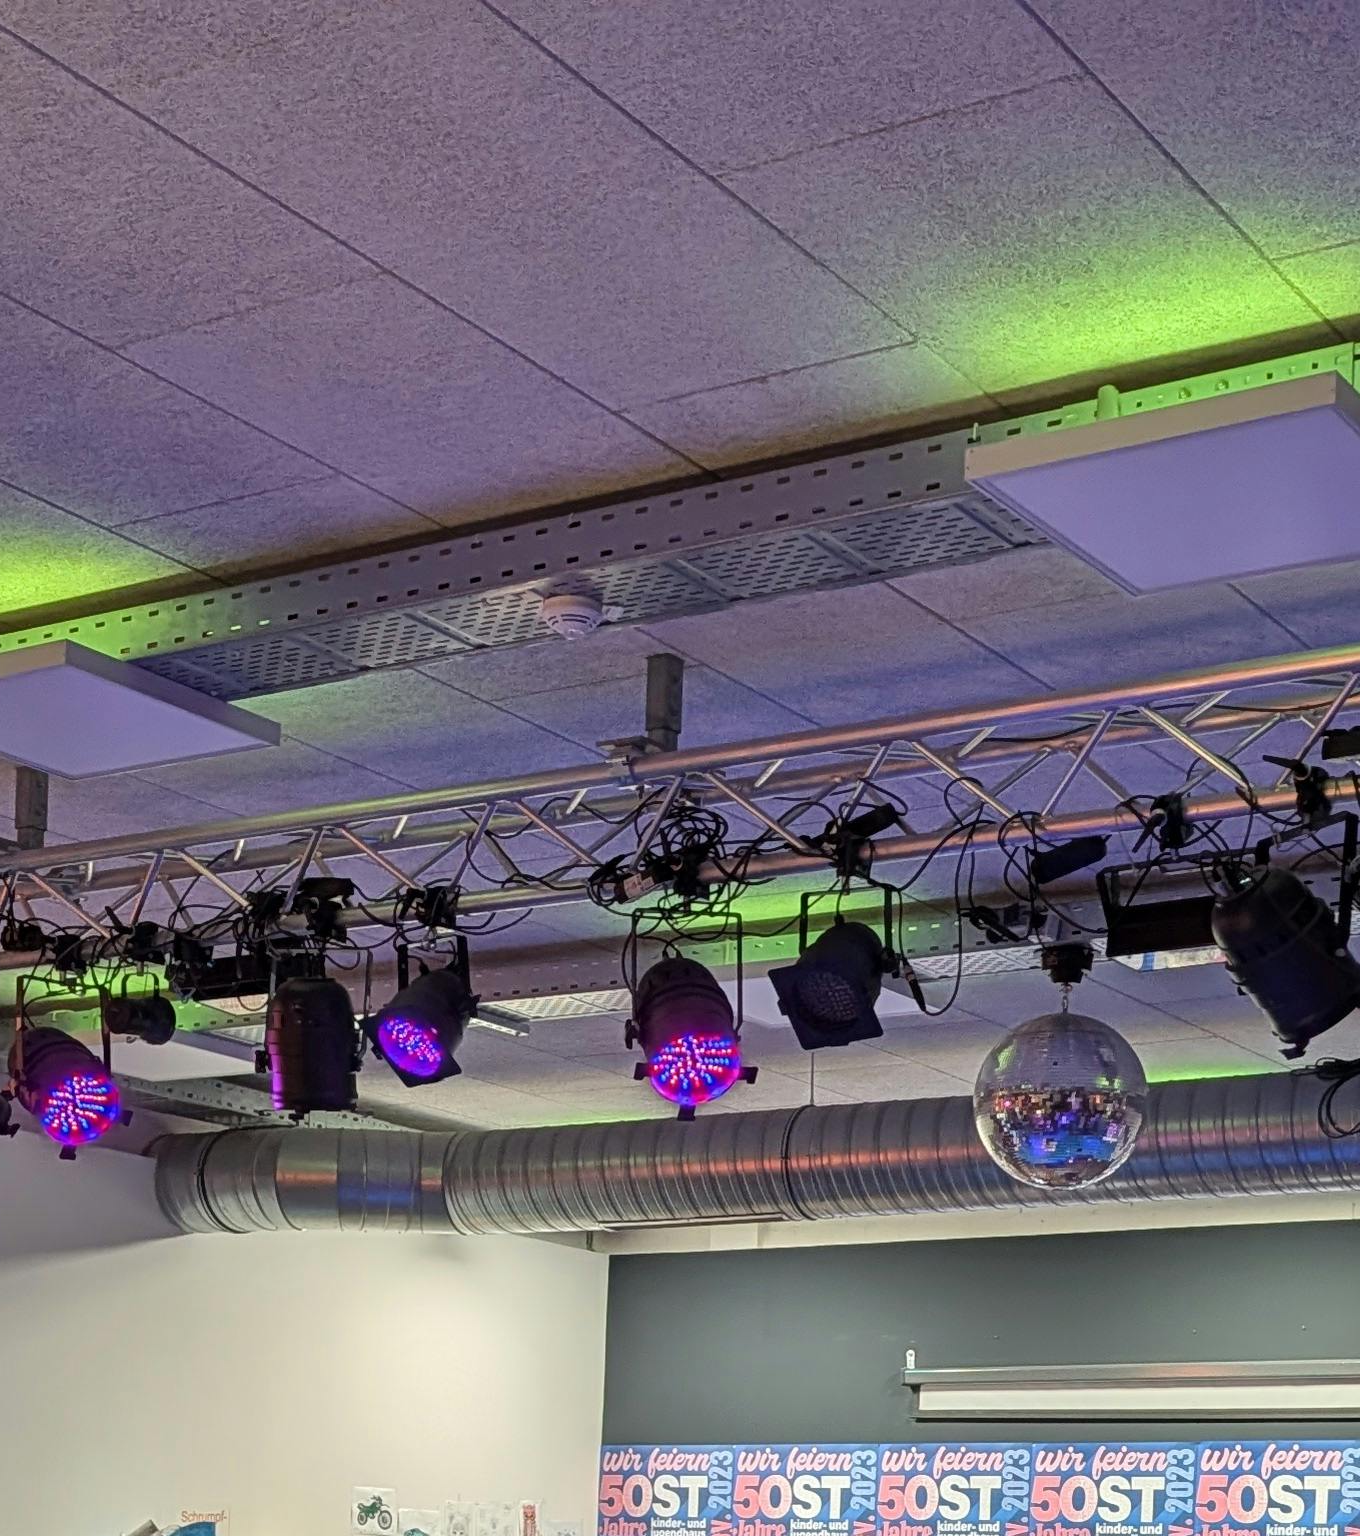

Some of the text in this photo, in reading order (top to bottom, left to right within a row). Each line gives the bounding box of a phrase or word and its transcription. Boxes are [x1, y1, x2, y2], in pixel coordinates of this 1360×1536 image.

[603, 1449, 711, 1479] wir feiern
[740, 1447, 854, 1480] wir feiern
[882, 1447, 1004, 1480] wir feiern
[1035, 1446, 1167, 1480] wir feiern
[1200, 1444, 1343, 1480] wir feiern
[708, 1451, 732, 1510] 2023
[851, 1450, 877, 1510] 2023
[1001, 1450, 1030, 1511] 2023
[1165, 1449, 1195, 1513] 2023
[979, 1521, 1000, 1532] und
[1095, 1523, 1162, 1534] kinder- und
[1315, 1525, 1338, 1536] und
